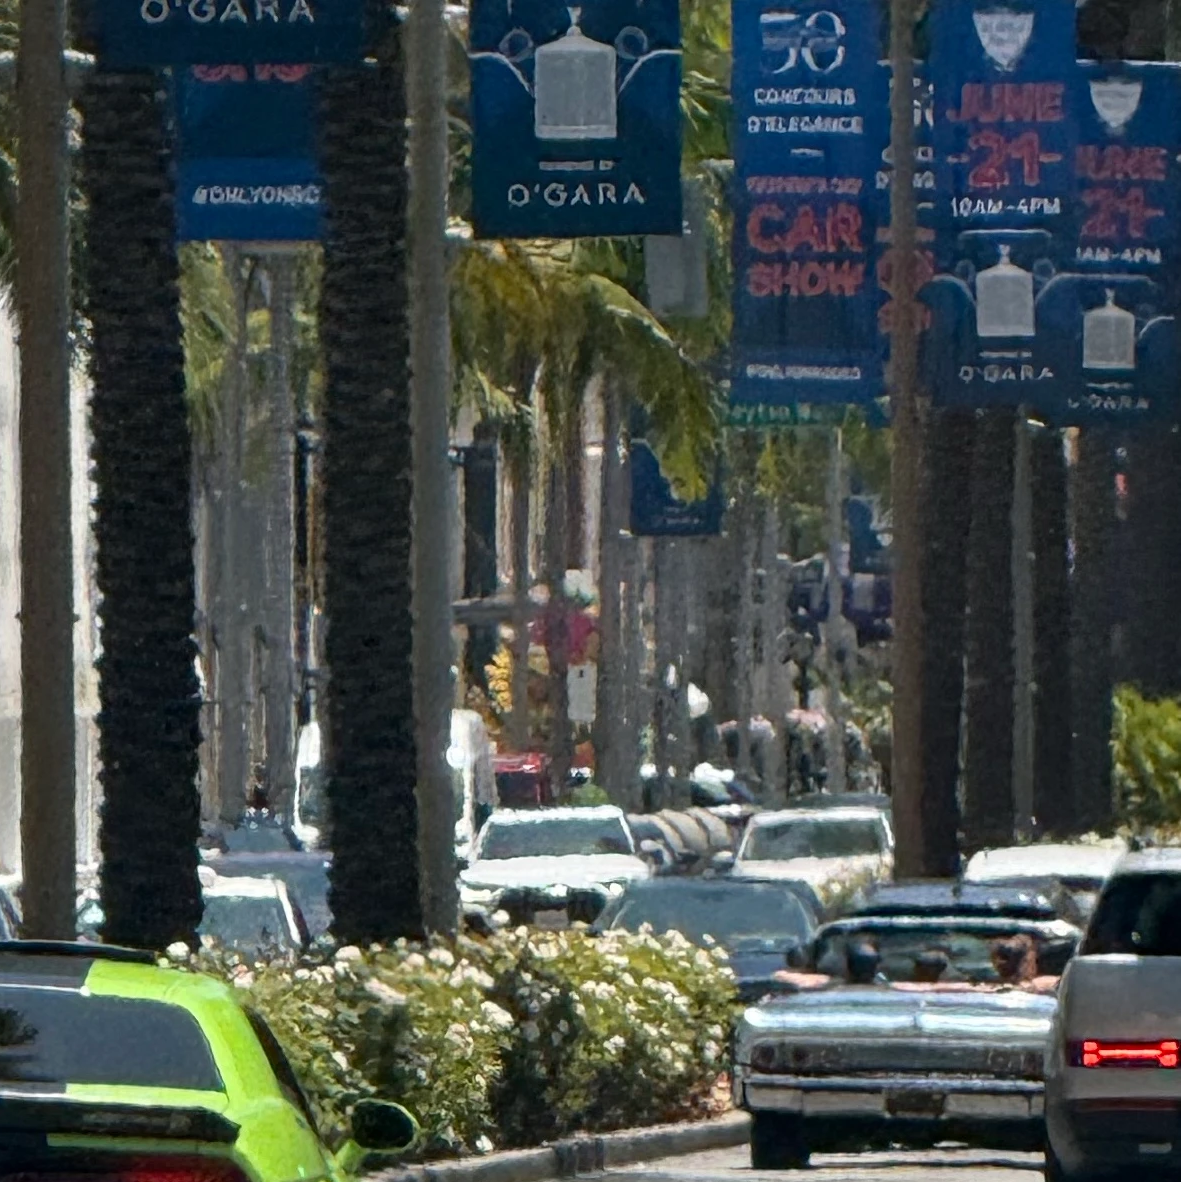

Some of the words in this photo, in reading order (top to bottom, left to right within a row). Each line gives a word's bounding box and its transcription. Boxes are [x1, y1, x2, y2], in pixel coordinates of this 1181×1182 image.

[140, 0, 315, 24] O'GARA
[945, 82, 1065, 123] JUNE
[507, 182, 646, 208] O'GARA
[746, 203, 864, 254] CAR
[747, 259, 866, 297] SHOW
